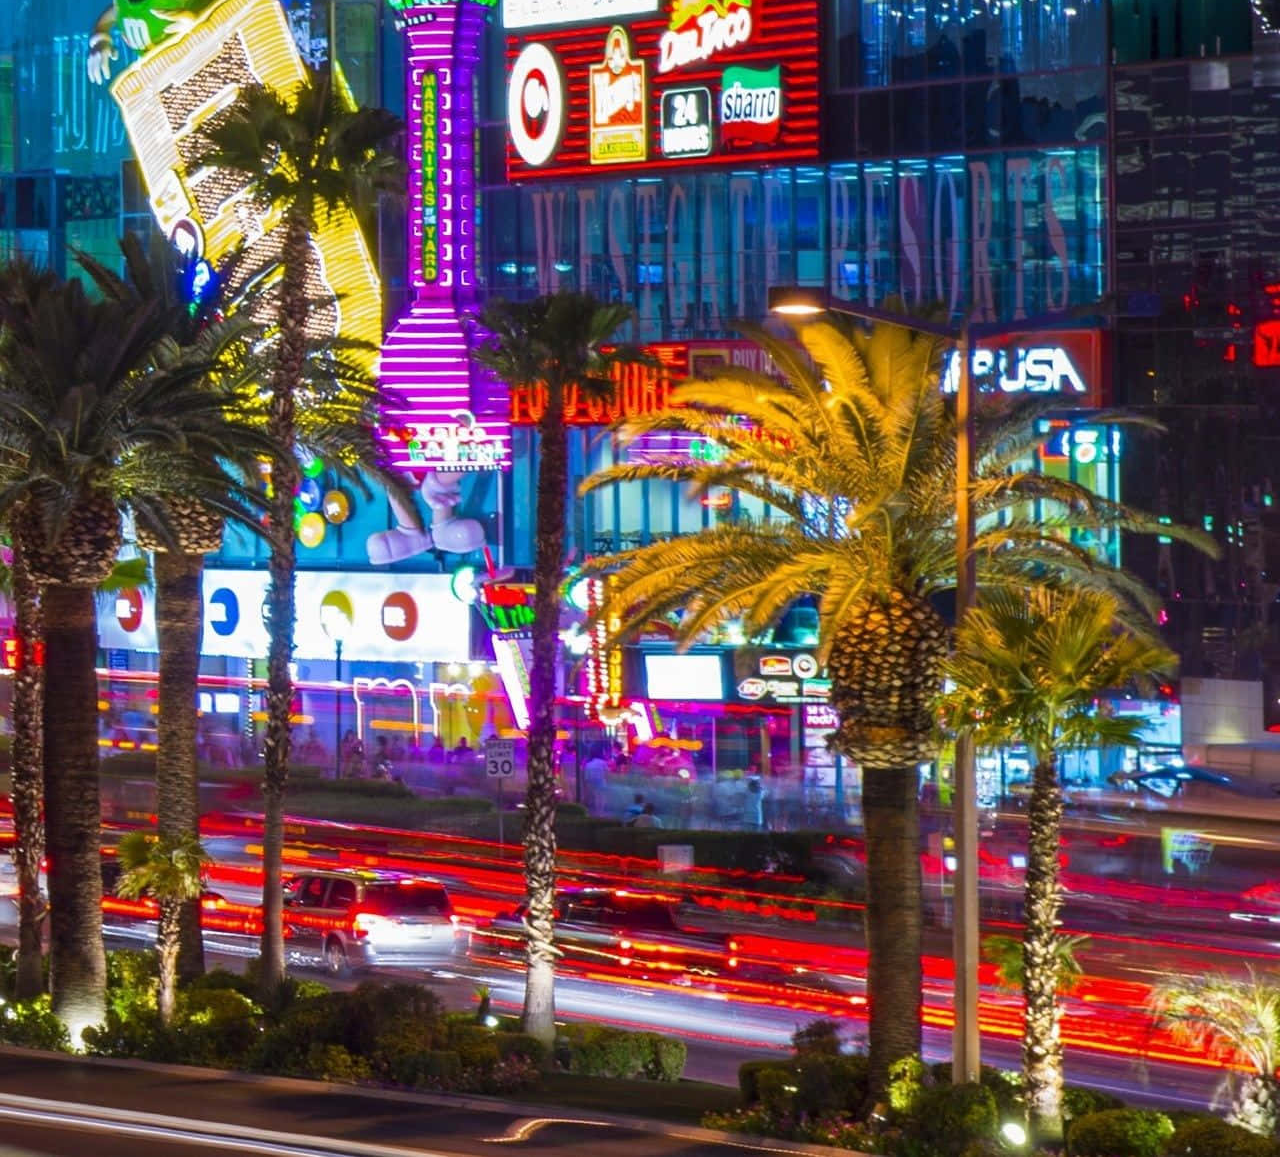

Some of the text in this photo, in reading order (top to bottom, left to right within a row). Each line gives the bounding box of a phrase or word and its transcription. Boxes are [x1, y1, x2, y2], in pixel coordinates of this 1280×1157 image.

[659, 31, 702, 73] DEL
[673, 94, 698, 126] 24
[724, 86, 776, 121] sbarro
[423, 73, 436, 206] MARGARITAS
[424, 226, 437, 280] YARD
[531, 176, 788, 331] WESTGATE
[830, 157, 1070, 324] RESORTS
[999, 347, 1086, 392] USA
[488, 760, 513, 775] 30
